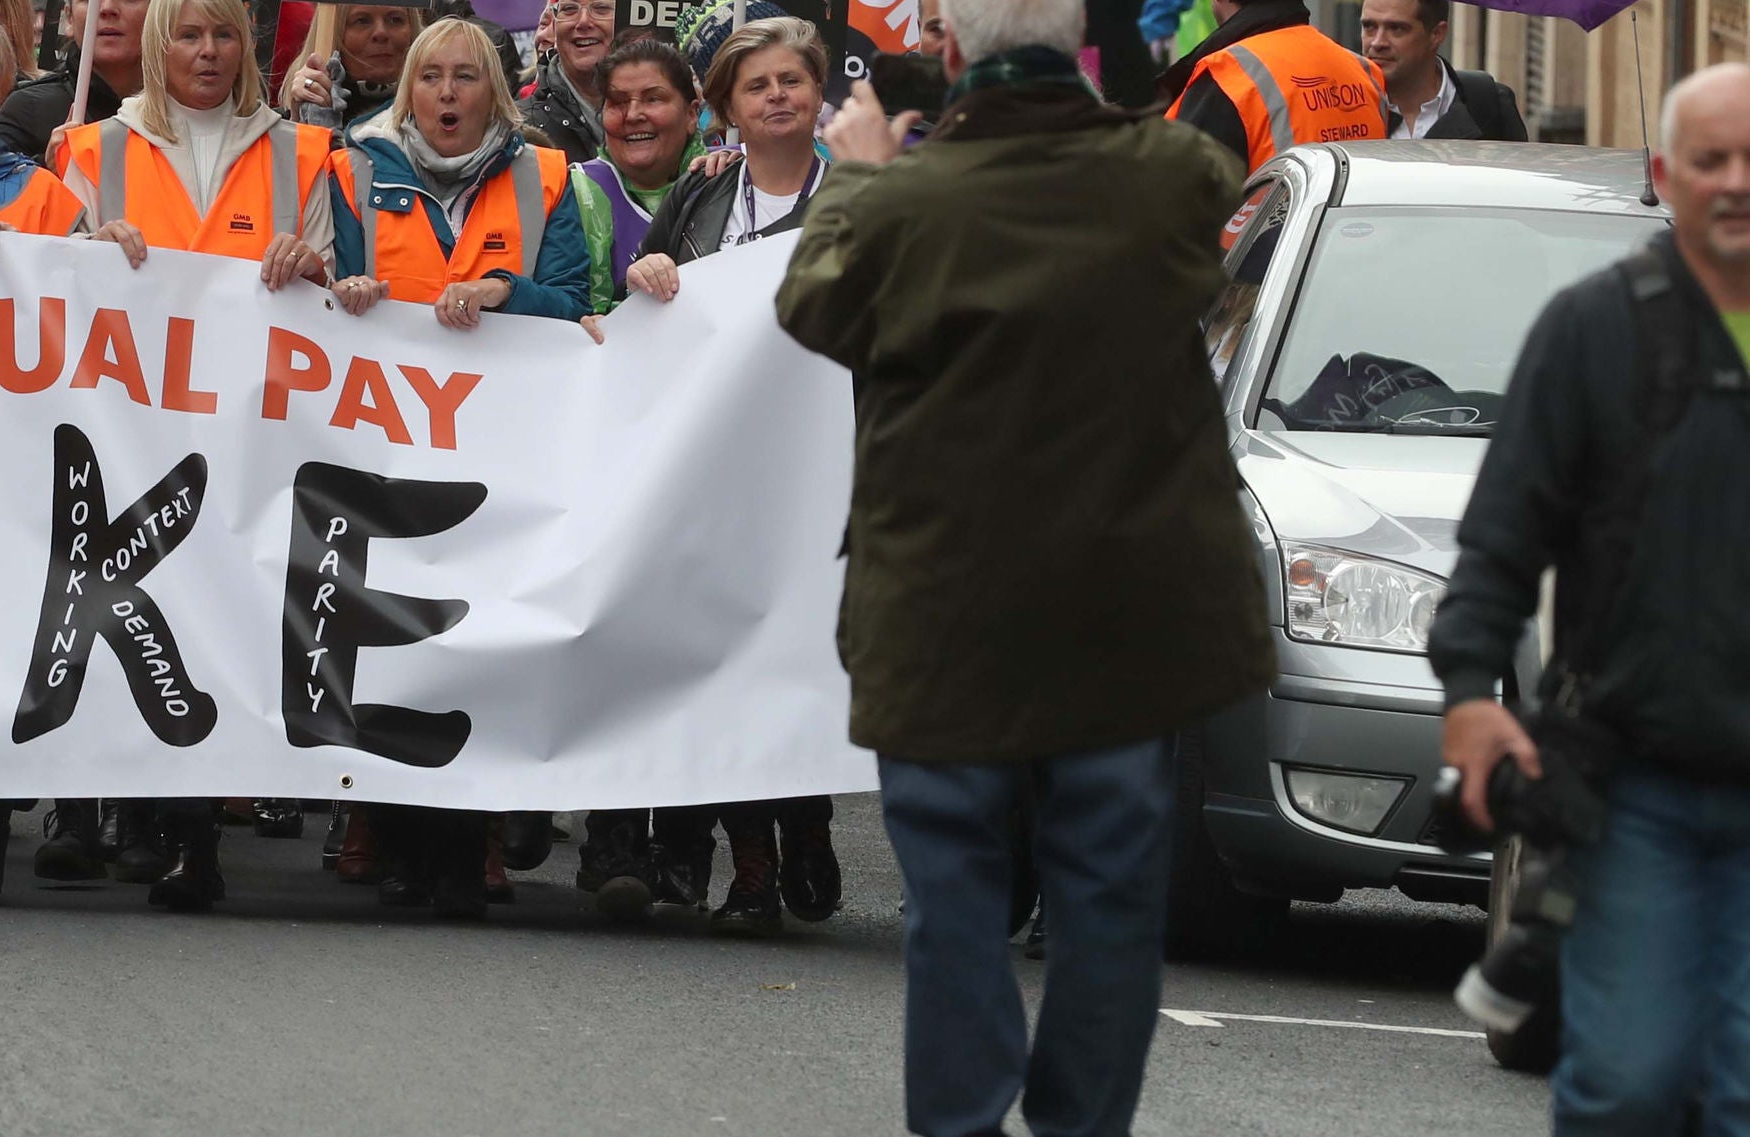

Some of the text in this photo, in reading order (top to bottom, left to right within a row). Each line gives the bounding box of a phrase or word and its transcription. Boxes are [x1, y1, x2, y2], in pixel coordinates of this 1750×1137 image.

[1302, 82, 1366, 112] UNISON
[1320, 123, 1369, 143] STEWARD
[260, 326, 485, 451] PAY
[46, 461, 194, 689] WORKING CONTEXT
[305, 516, 348, 714] PARITY
[111, 599, 191, 718] DEMAND
